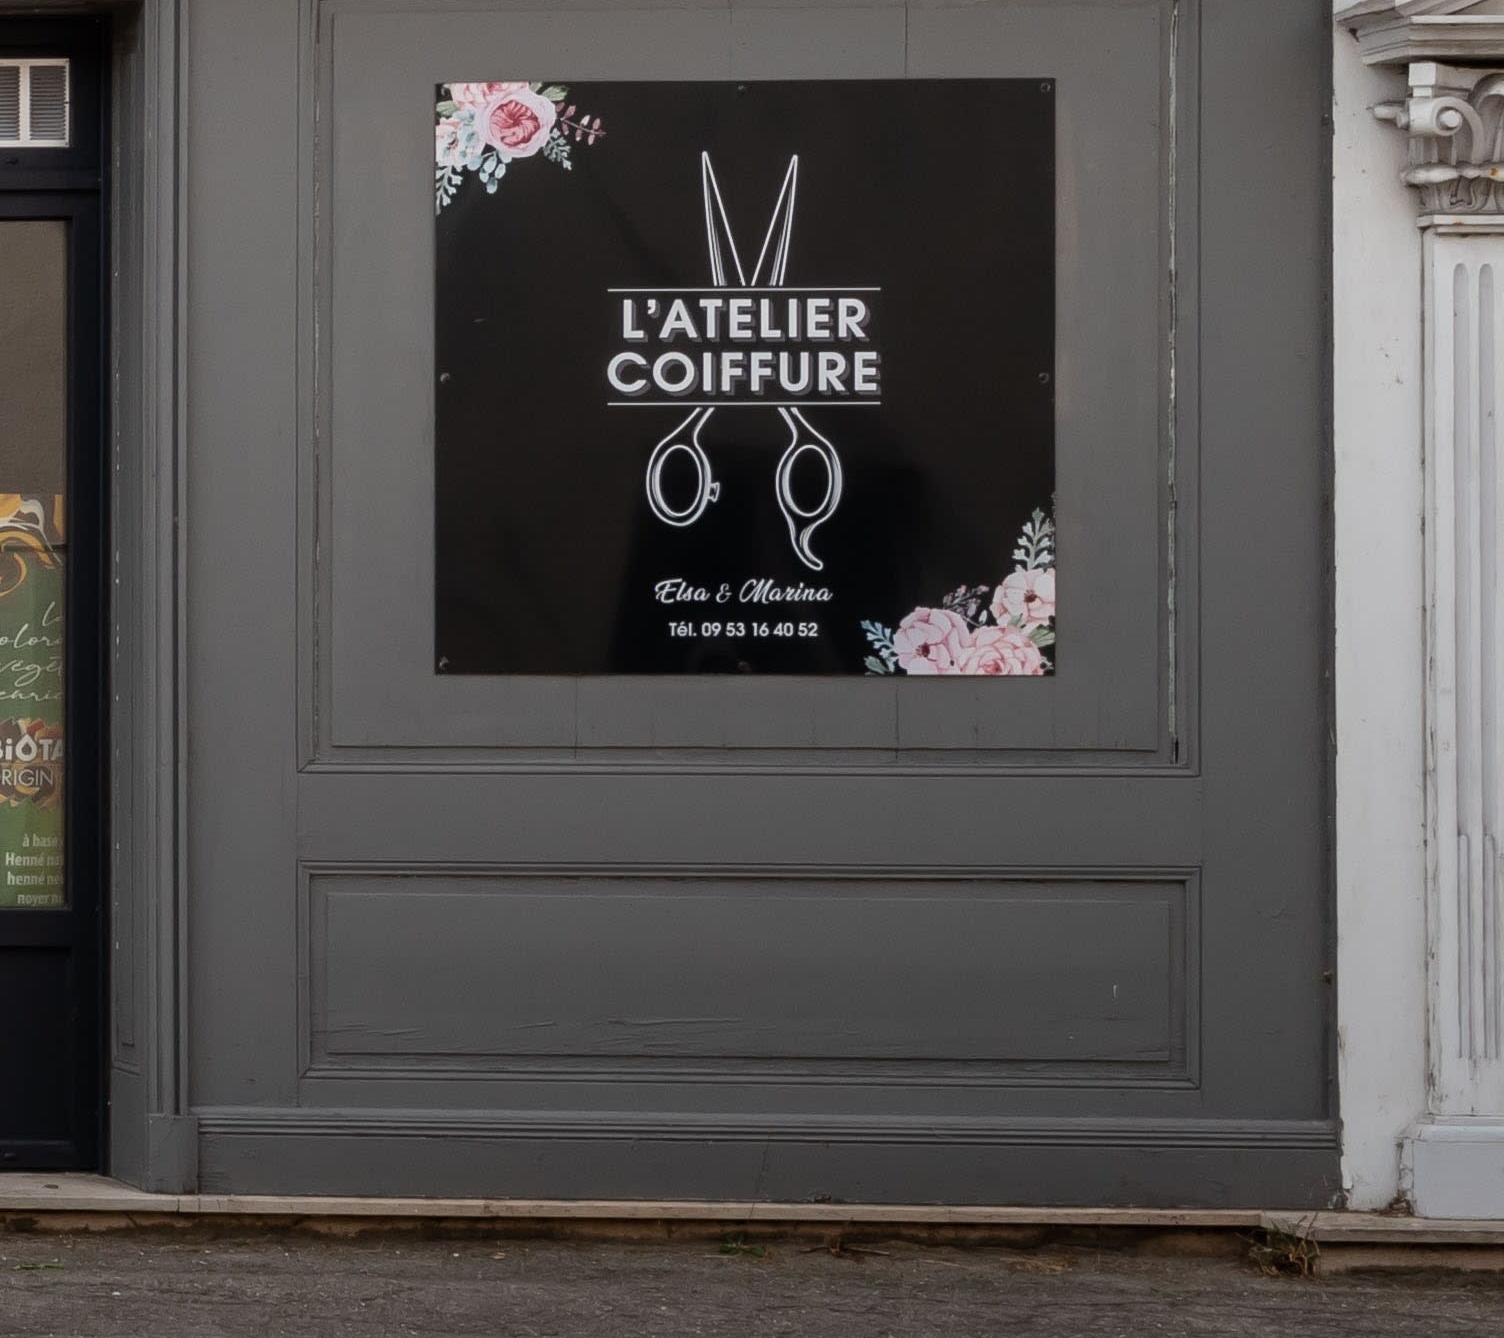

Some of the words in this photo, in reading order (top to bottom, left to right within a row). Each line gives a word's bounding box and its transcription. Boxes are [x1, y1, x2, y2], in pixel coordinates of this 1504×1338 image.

[622, 297, 870, 342] L'ATELIER
[606, 351, 882, 396] COIFFURE
[654, 578, 711, 604] Elsa
[715, 583, 733, 603] &
[738, 578, 834, 604] Marina
[668, 622, 698, 637] Tél.
[701, 622, 722, 637] 09
[725, 622, 746, 637] 53
[751, 622, 770, 637] 16
[773, 622, 794, 637] 40
[797, 622, 819, 637] 52
[22, 833, 30, 848] à
[4, 851, 45, 867] Henné
[7, 871, 45, 886] henné
